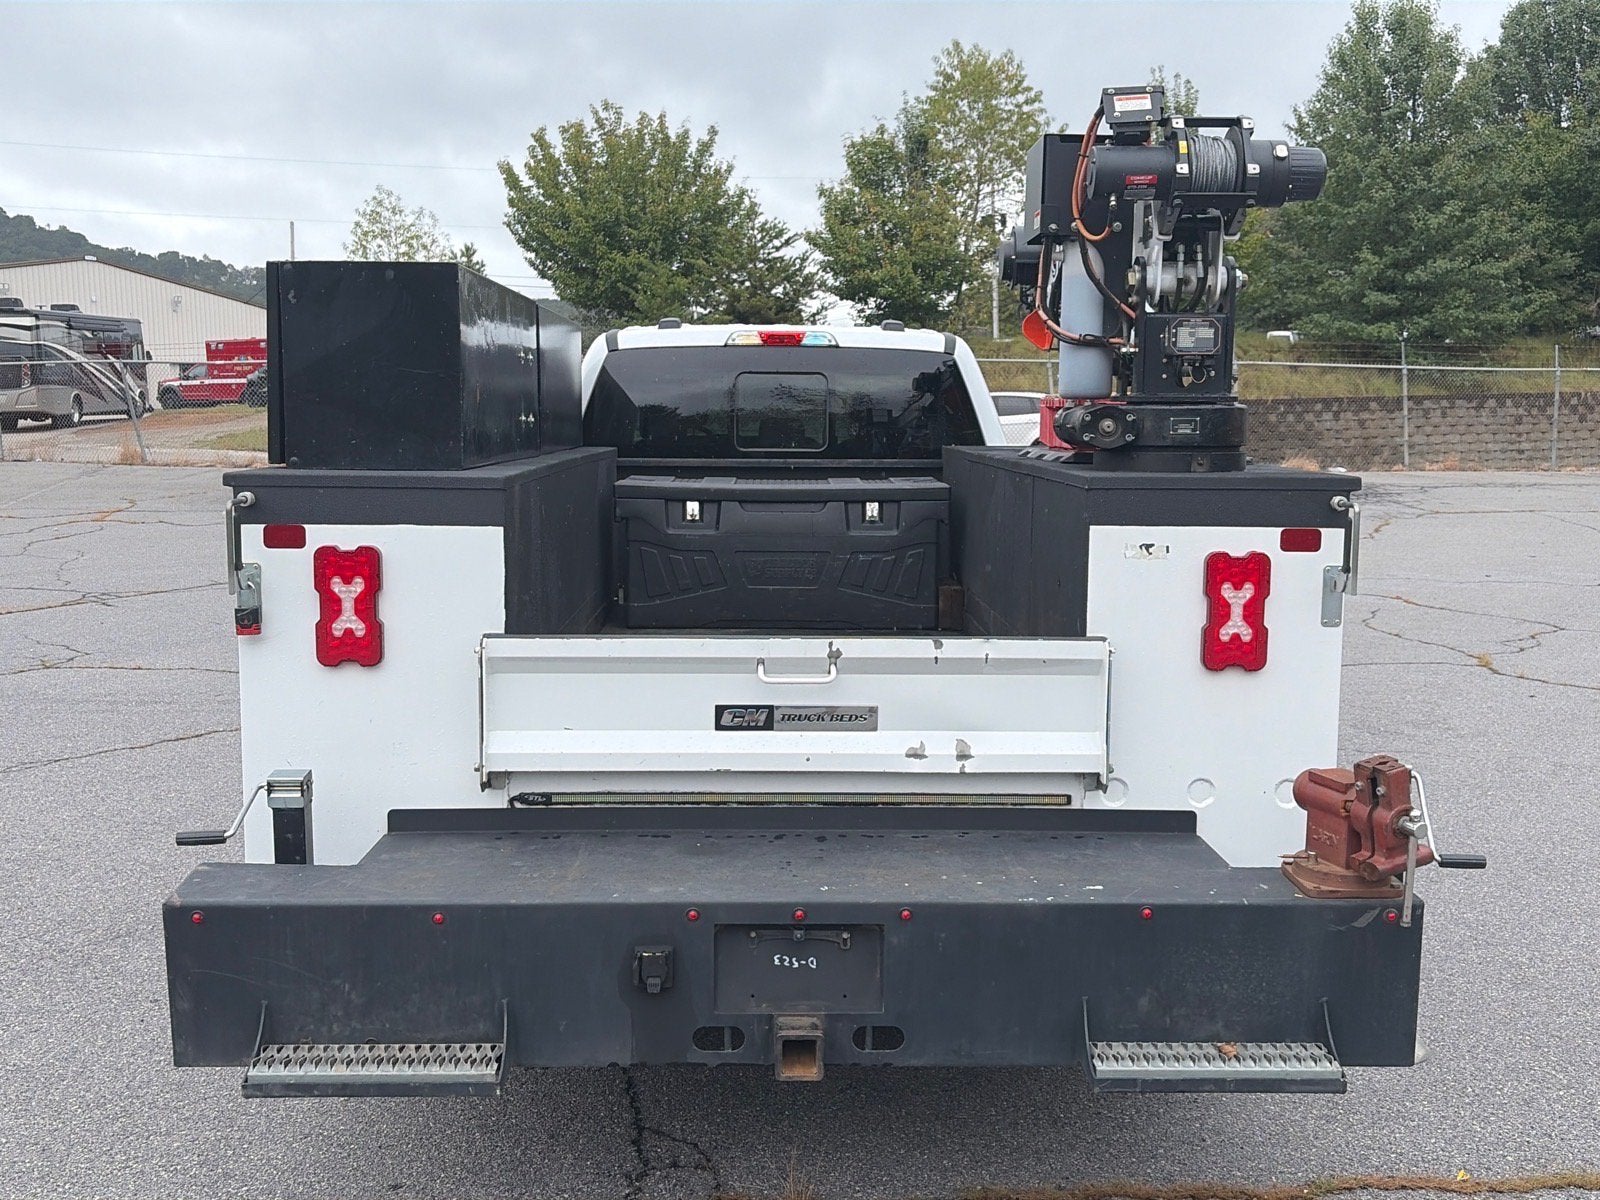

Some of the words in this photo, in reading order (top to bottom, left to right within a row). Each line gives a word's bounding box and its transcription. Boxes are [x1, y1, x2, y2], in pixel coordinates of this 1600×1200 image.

[720, 709, 768, 726] CM
[780, 713, 826, 722] TRUCK
[773, 954, 817, 969] D-523
